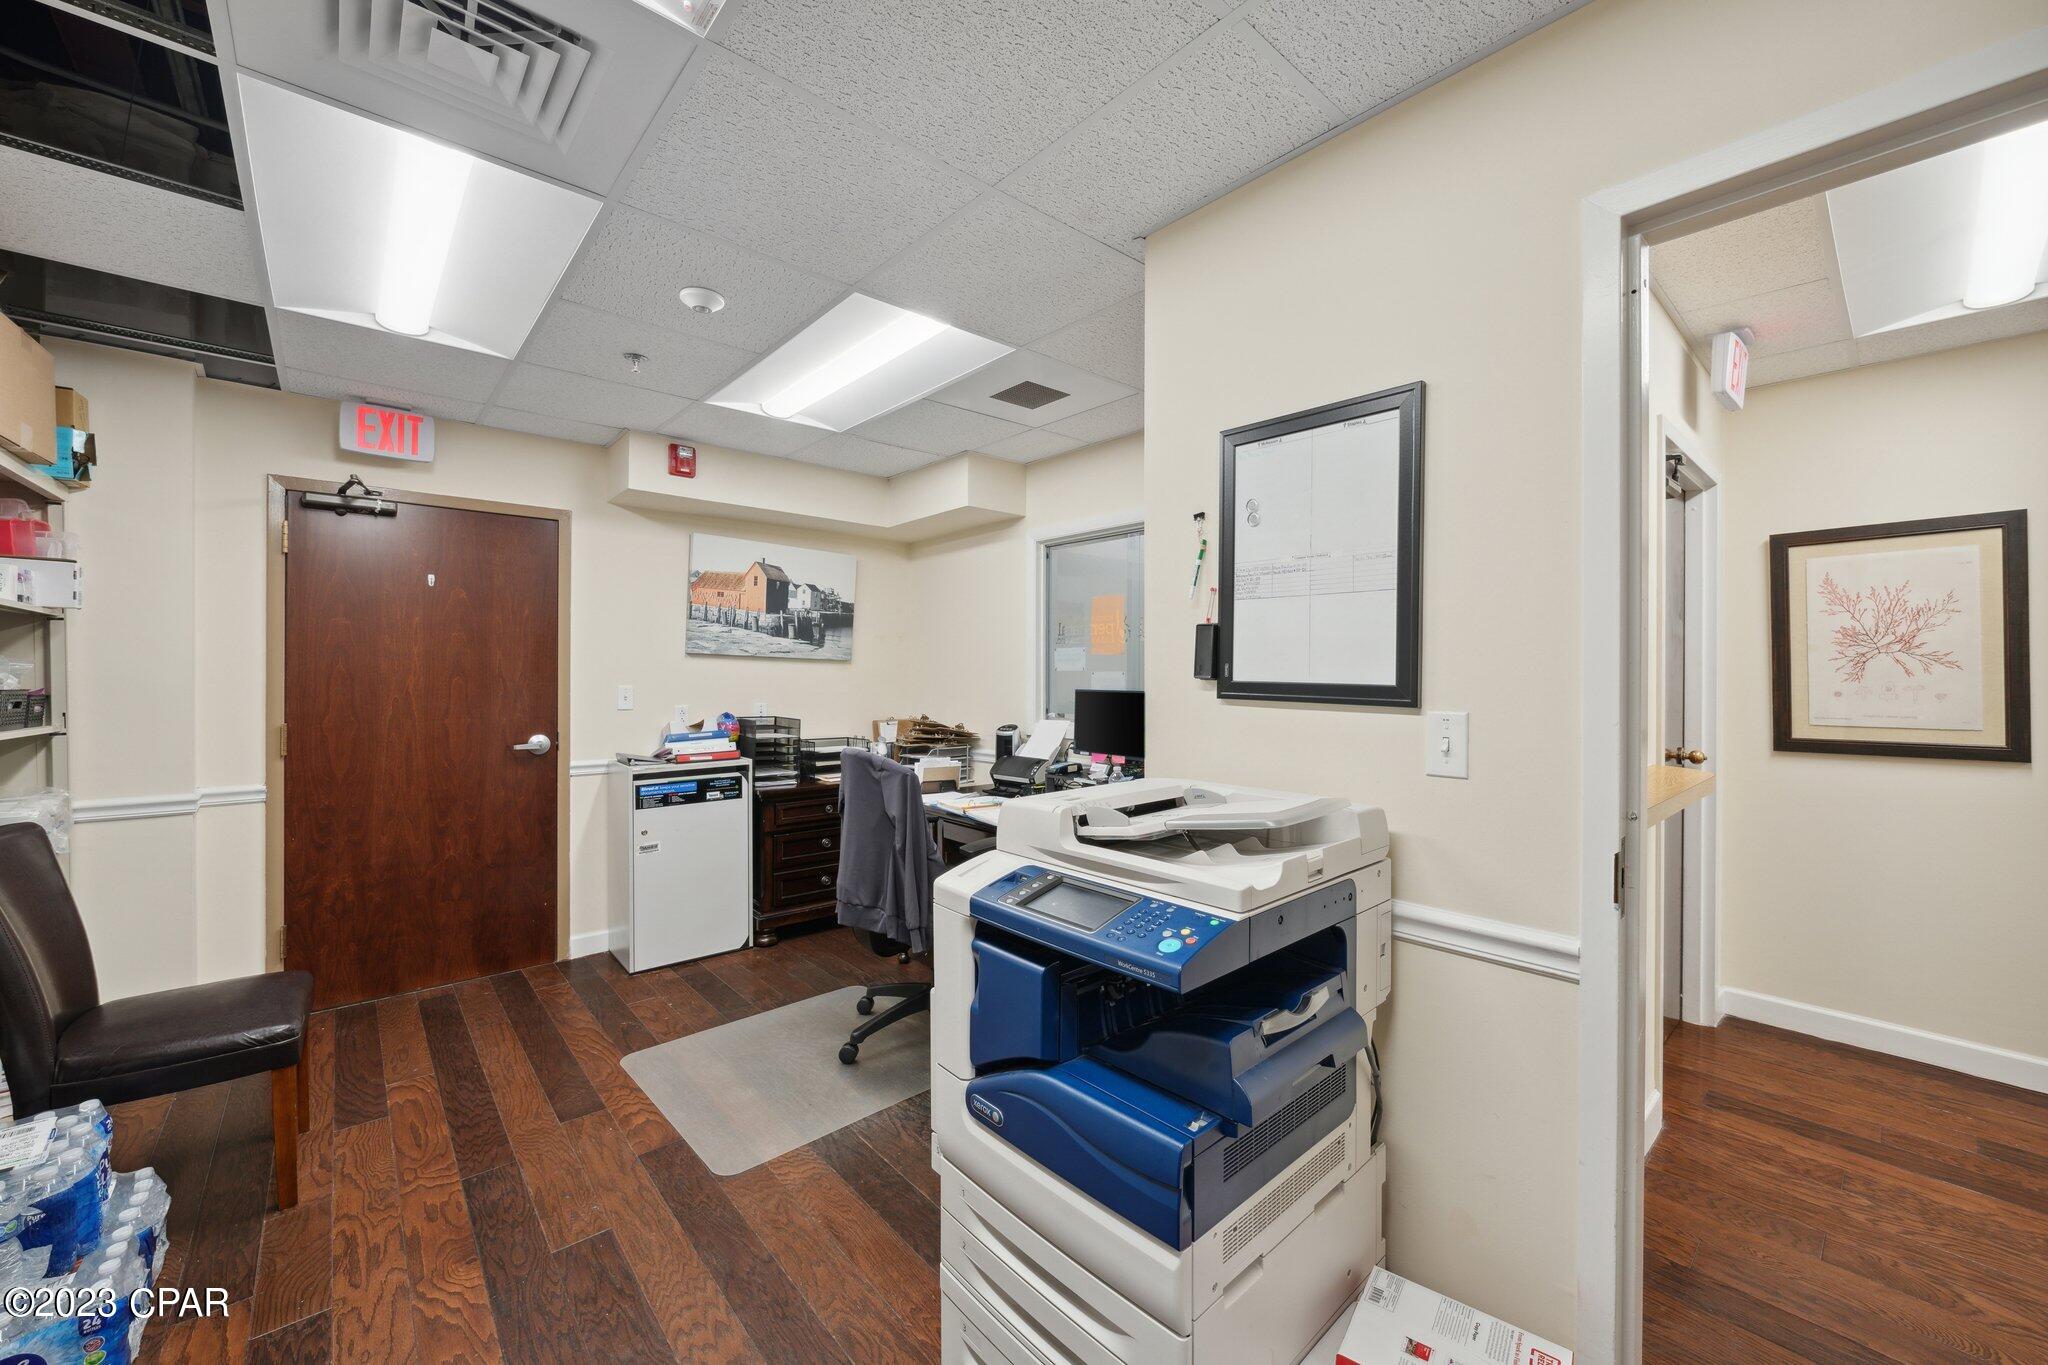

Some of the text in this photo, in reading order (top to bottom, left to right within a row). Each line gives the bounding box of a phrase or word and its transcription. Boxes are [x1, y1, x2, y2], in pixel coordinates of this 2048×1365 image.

[356, 405, 424, 456] EXIT
[1117, 959, 1143, 974] WorkCentre
[973, 1099, 991, 1116] xerox
